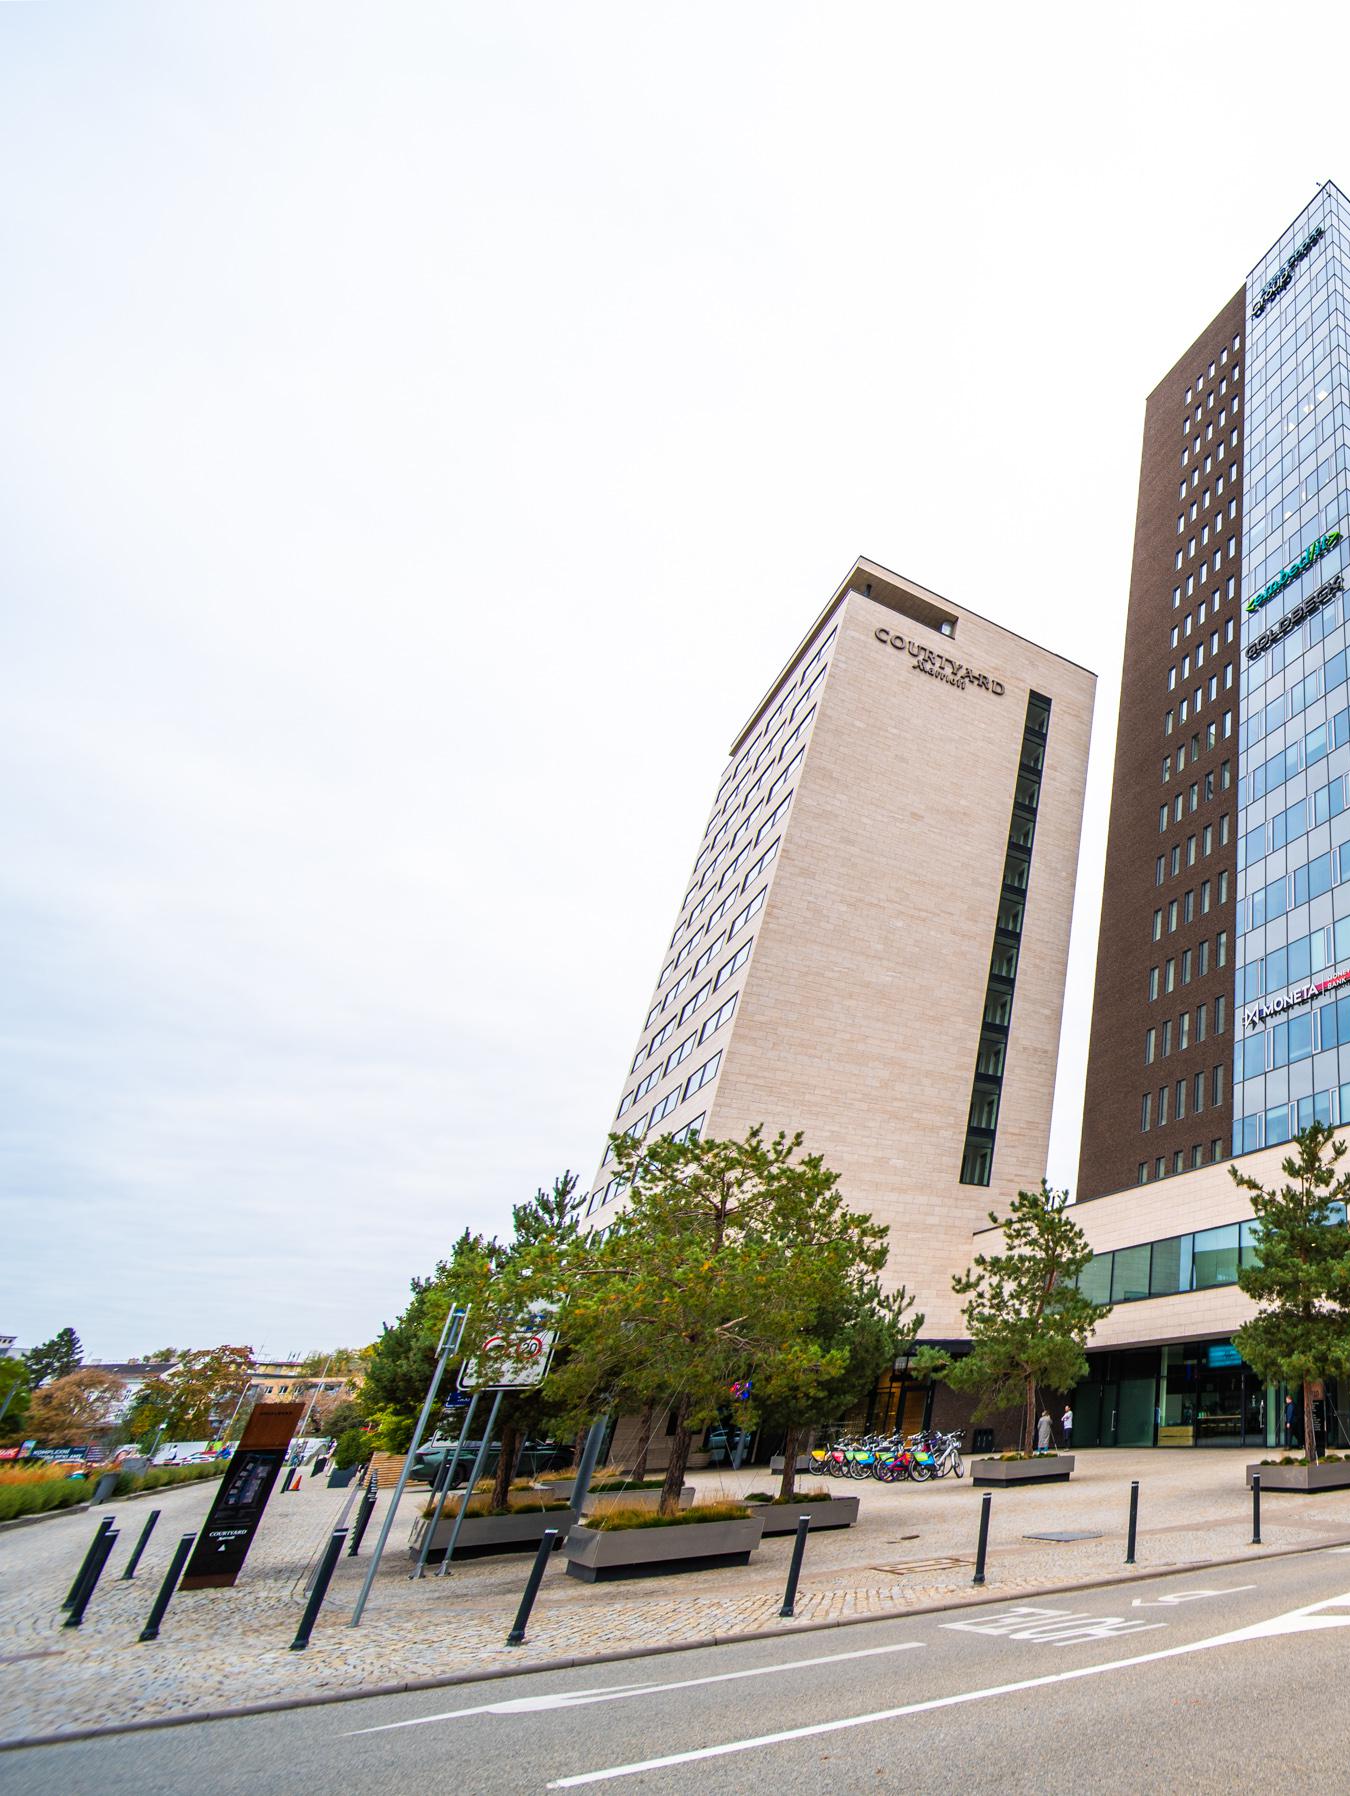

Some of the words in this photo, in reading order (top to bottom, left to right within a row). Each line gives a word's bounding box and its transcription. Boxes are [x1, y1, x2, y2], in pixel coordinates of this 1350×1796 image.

[1245, 576, 1344, 660] GOLDBECK
[874, 627, 1006, 696] COURTYARD
[912, 659, 966, 691] Marriott
[1327, 968, 1350, 981] MONEY
[1327, 976, 1347, 989] BANK
[1262, 984, 1319, 1017] MONETA
[937, 1606, 1169, 1647] HOTEL
